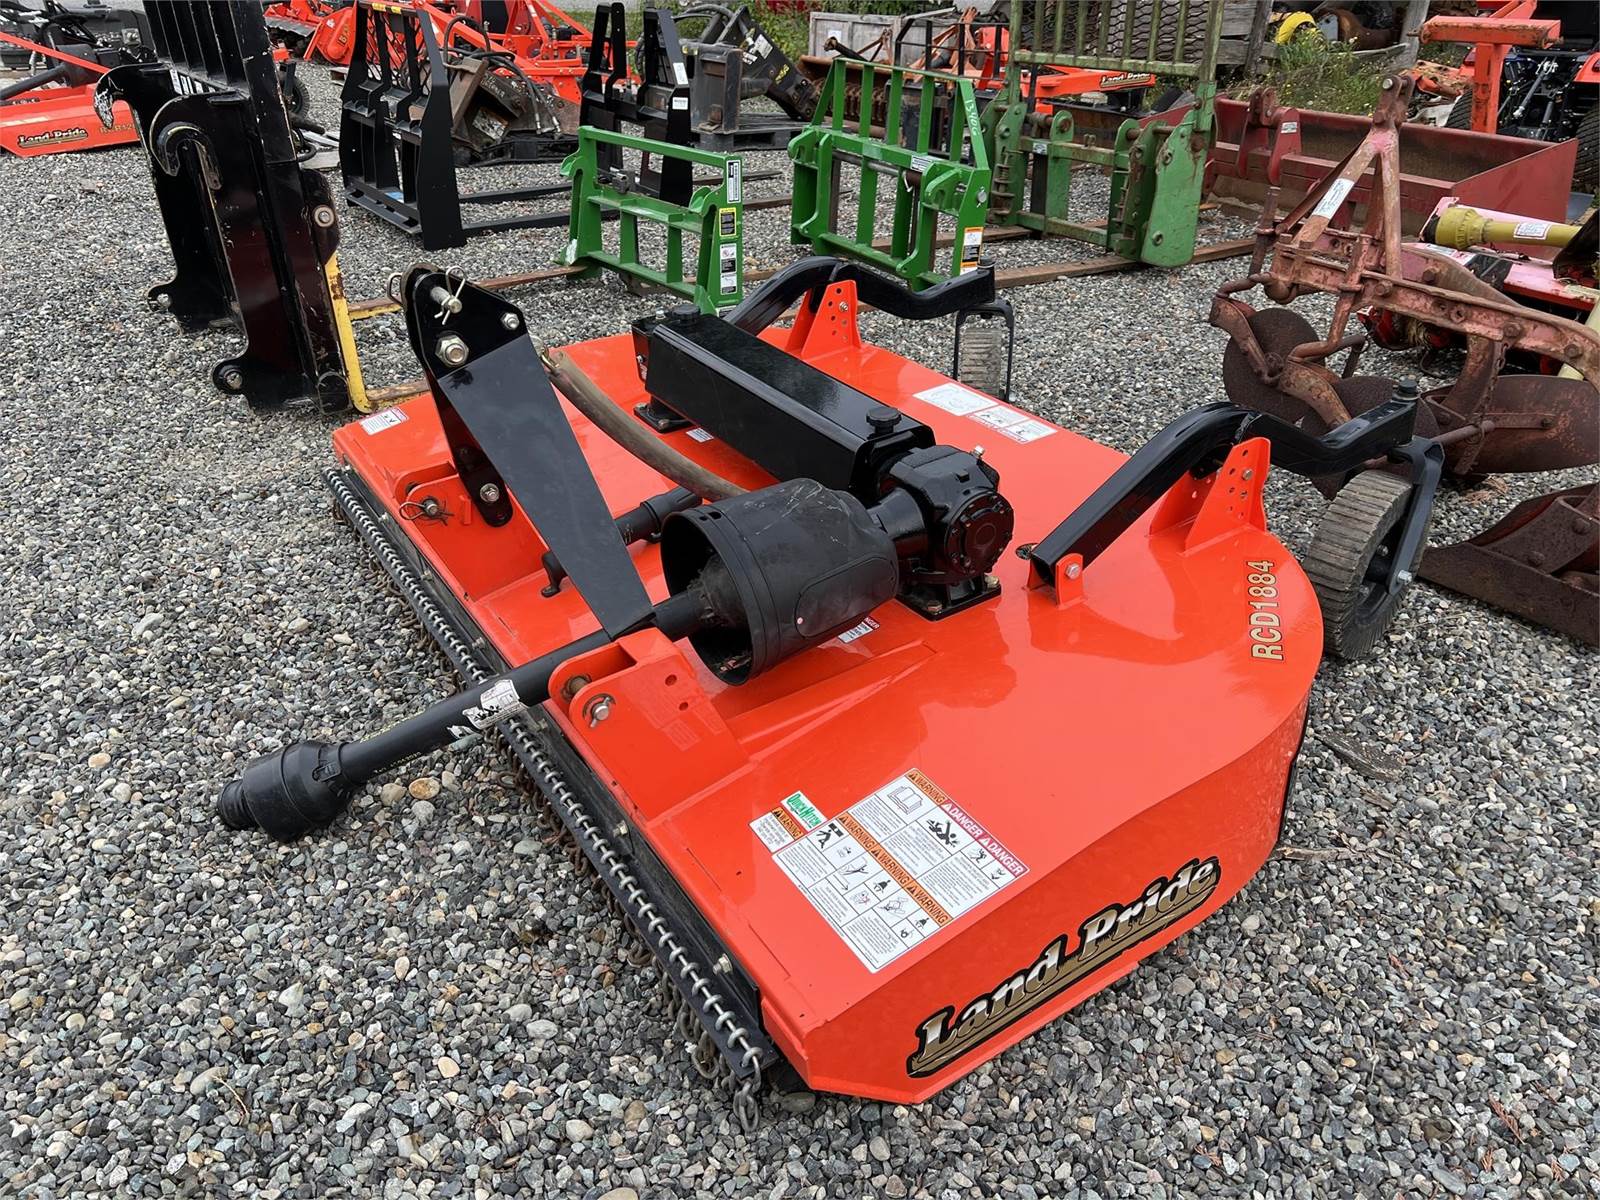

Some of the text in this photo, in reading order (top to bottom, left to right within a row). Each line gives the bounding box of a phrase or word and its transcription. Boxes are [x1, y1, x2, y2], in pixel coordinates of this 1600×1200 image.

[19, 128, 86, 144] Land Pride
[1247, 560, 1284, 661] RCD1884
[914, 776, 946, 804] WARNING
[780, 812, 802, 837] WARNING
[845, 820, 875, 849] WARNING
[949, 804, 983, 840] DANGER
[879, 853, 910, 886] WARNING
[986, 840, 1024, 878] DANGER
[914, 890, 950, 925] WARNING
[914, 938, 1066, 1065] Land
[1077, 858, 1216, 961] Pride
